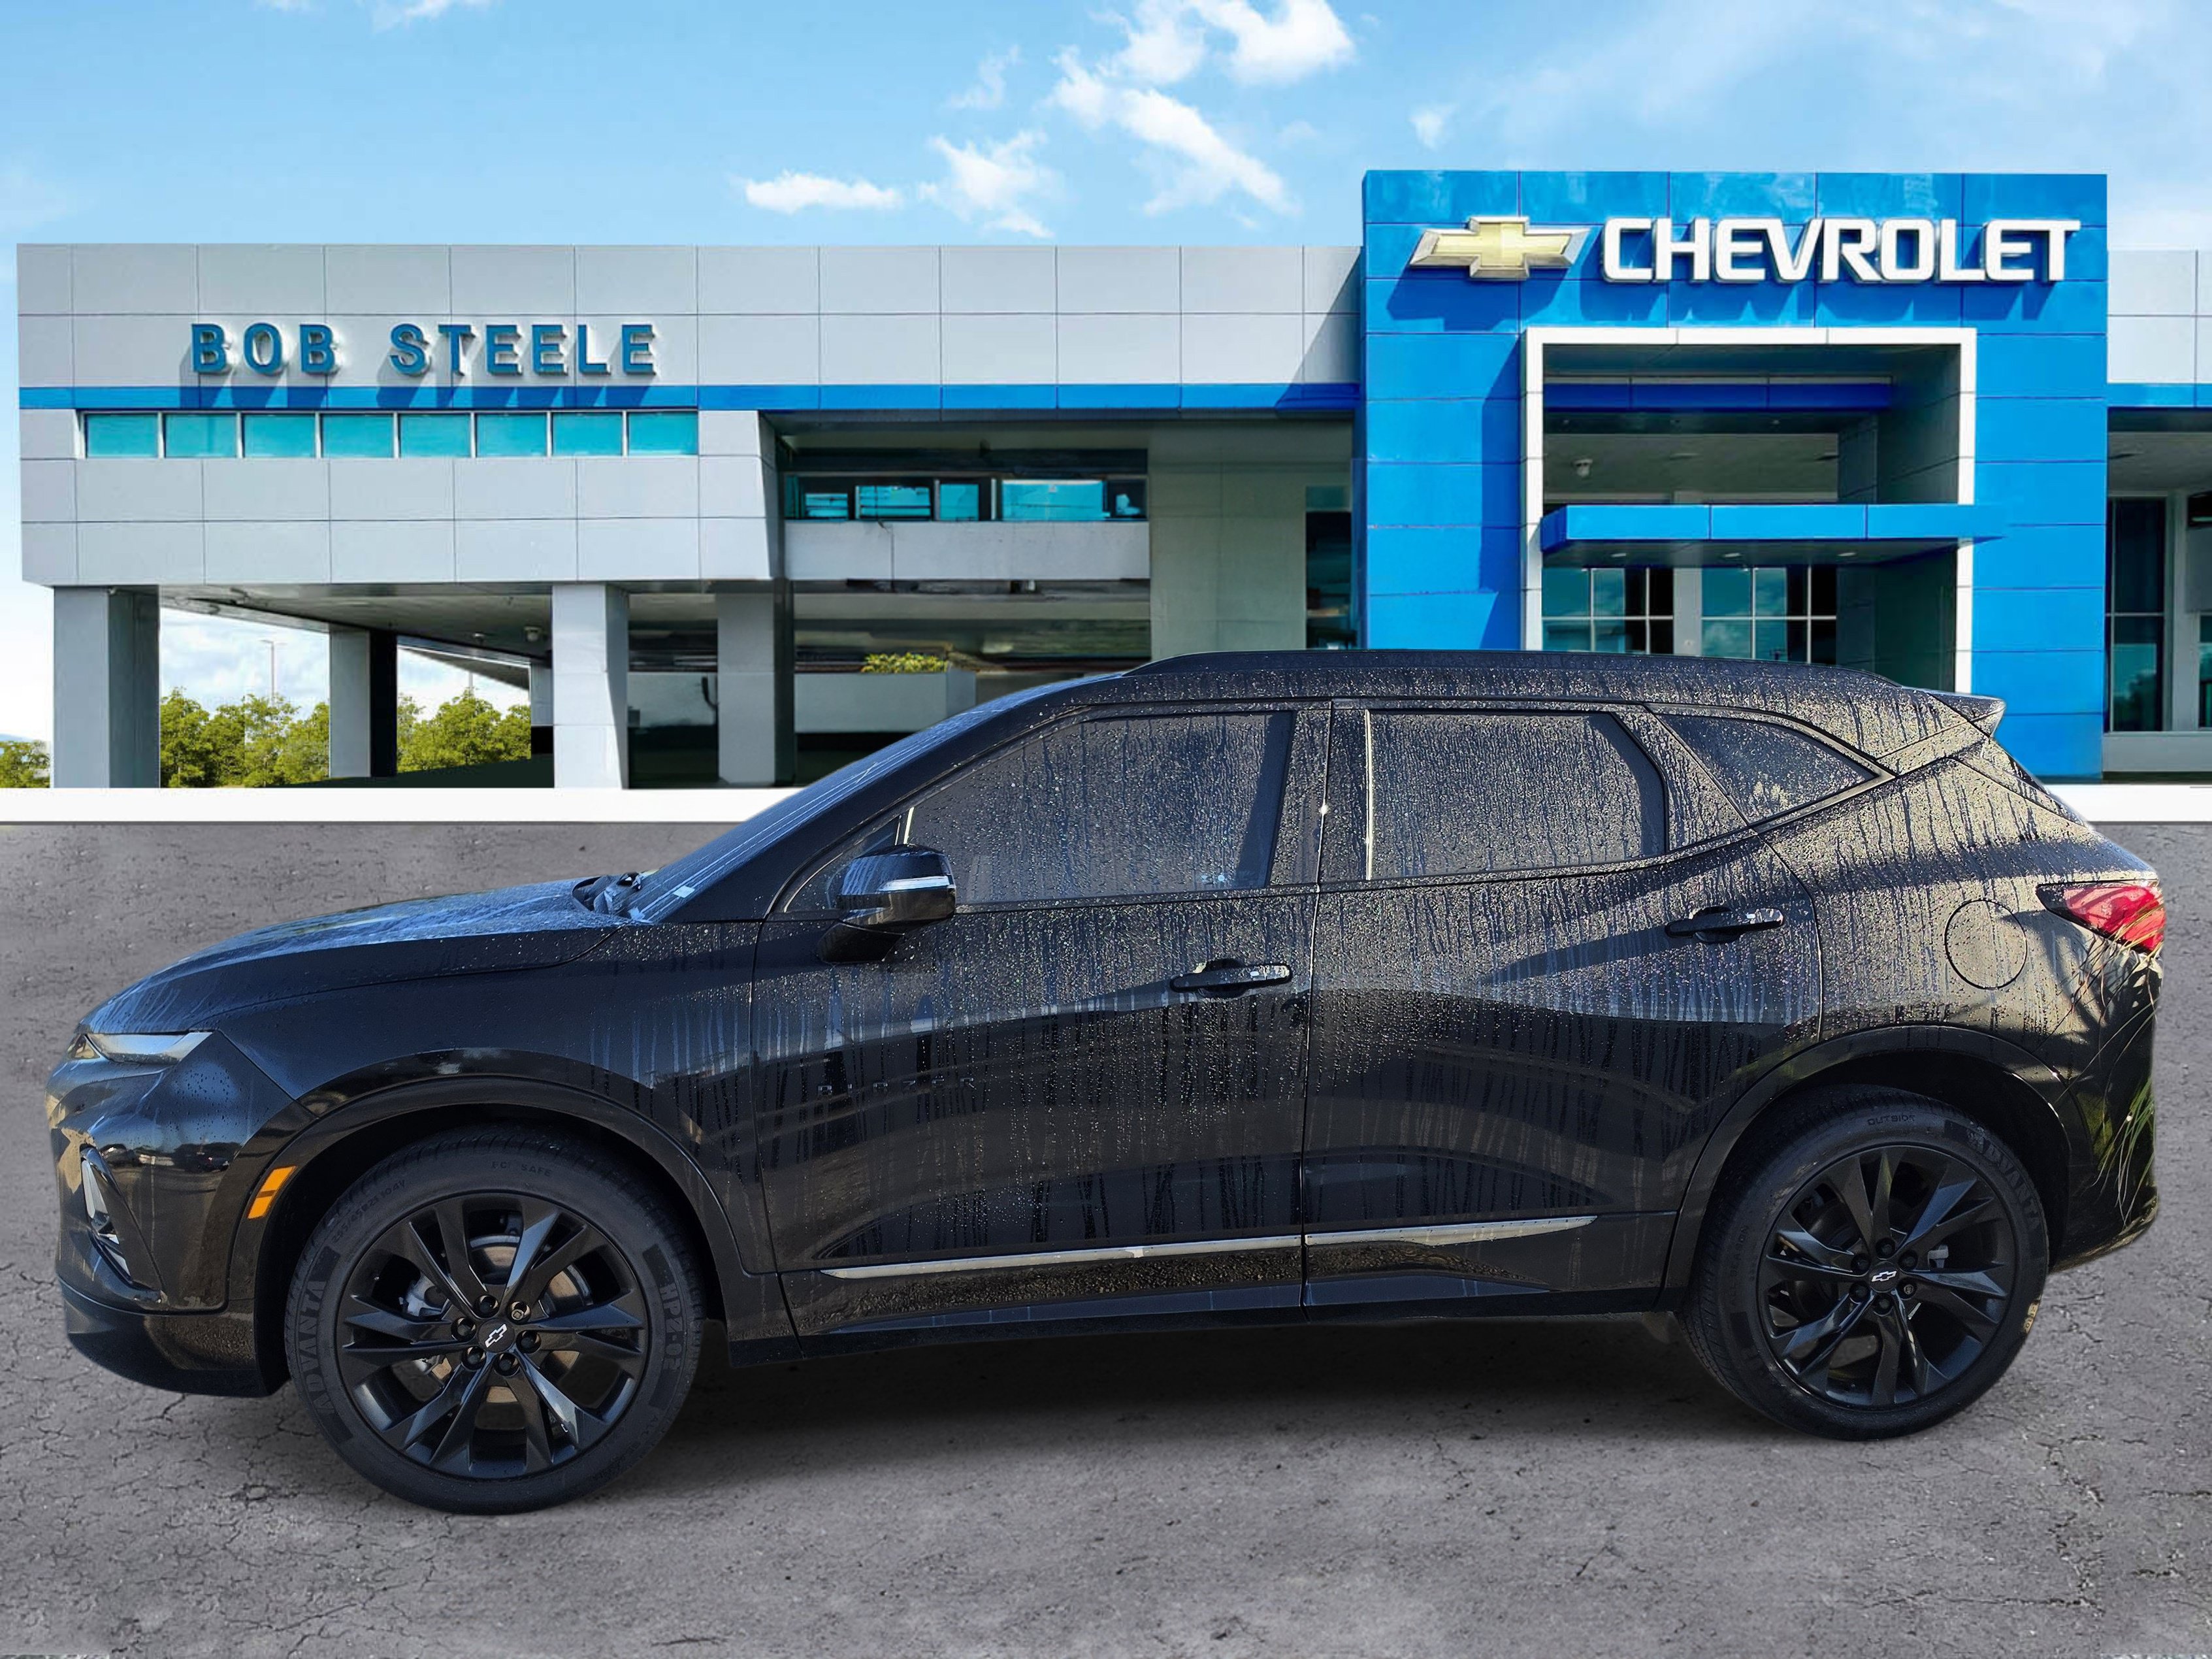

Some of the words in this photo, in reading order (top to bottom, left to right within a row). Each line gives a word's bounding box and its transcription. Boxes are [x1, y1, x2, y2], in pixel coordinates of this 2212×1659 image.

[1602, 217, 2081, 282] CHEVROLET
[191, 322, 338, 376] BOB
[389, 322, 659, 376] STEELE
[299, 1280, 336, 1414] ADVANTA
